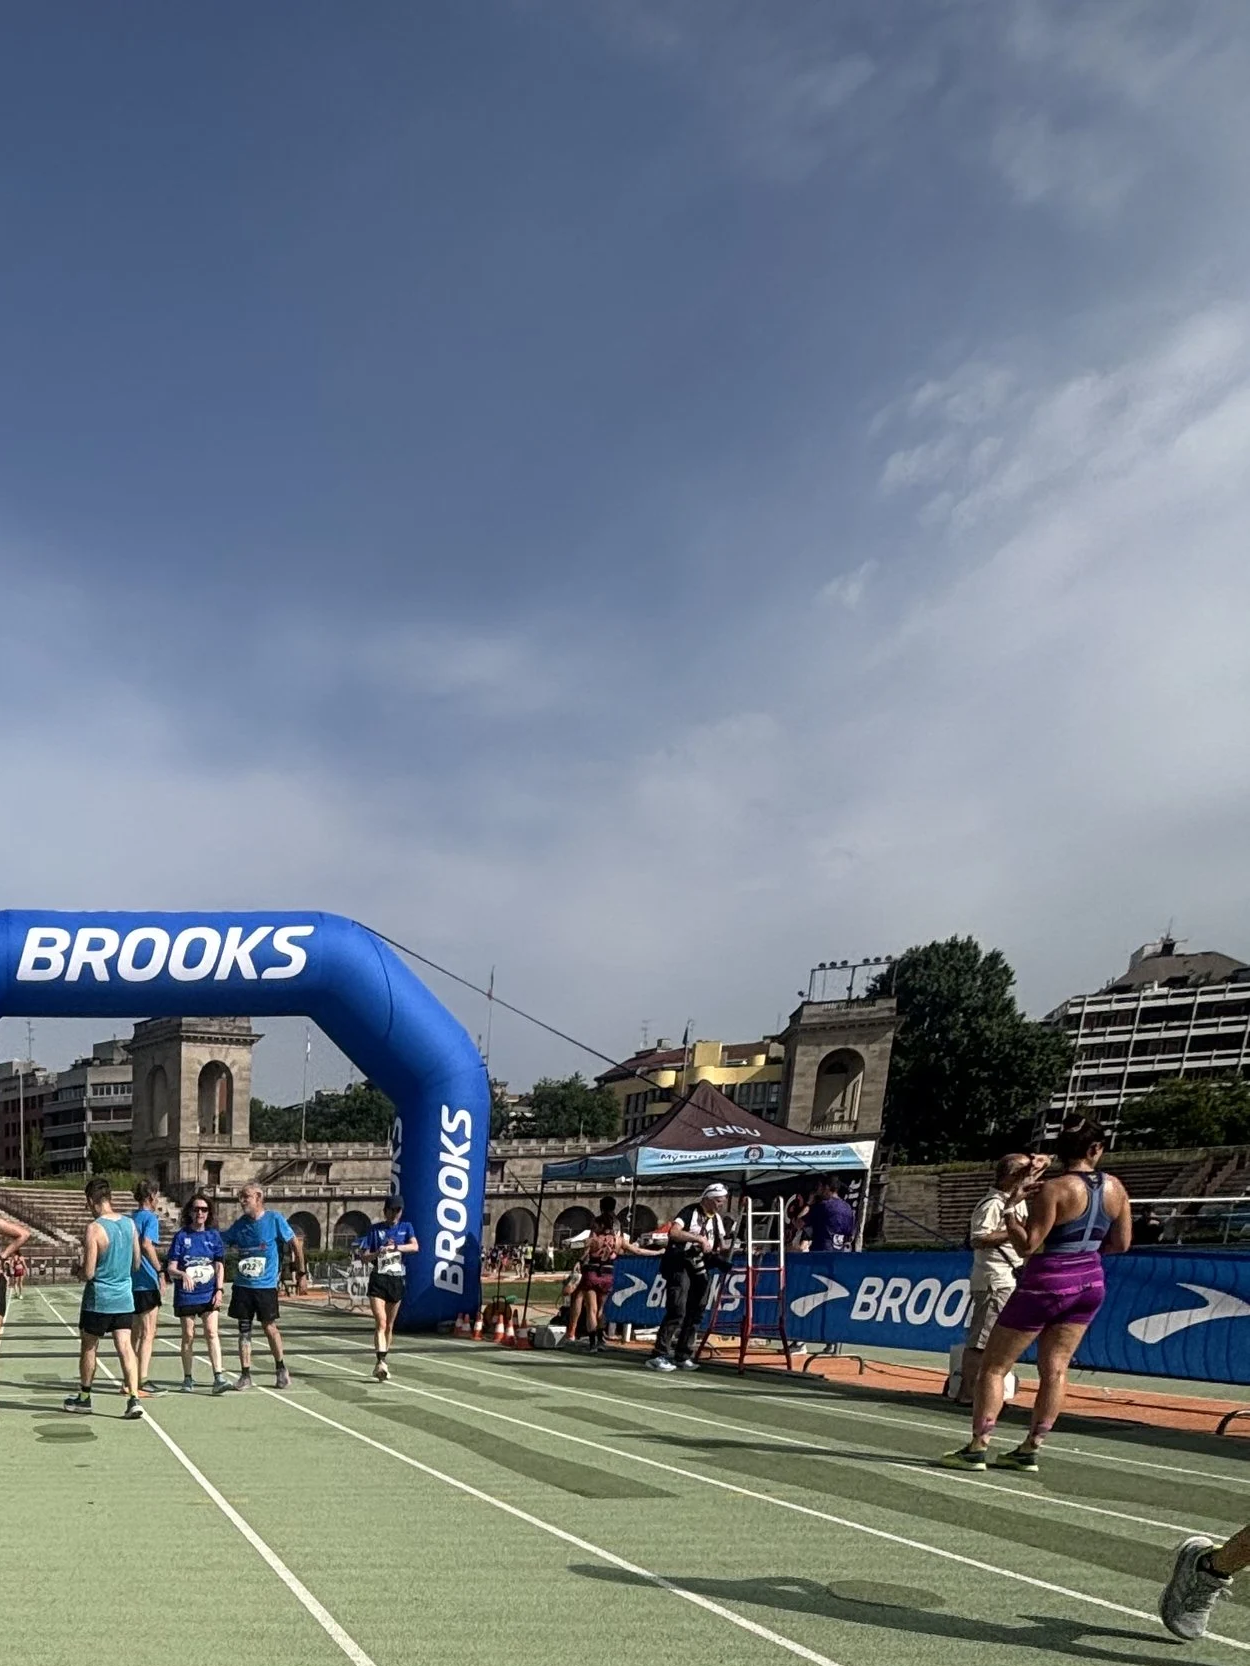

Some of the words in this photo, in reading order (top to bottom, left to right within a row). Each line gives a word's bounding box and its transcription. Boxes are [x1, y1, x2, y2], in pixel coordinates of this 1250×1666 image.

[16, 926, 314, 982] BROOKS
[701, 1126, 761, 1138] ENDU
[433, 1104, 472, 1295] BROOKS
[850, 1276, 975, 1329] BROO
